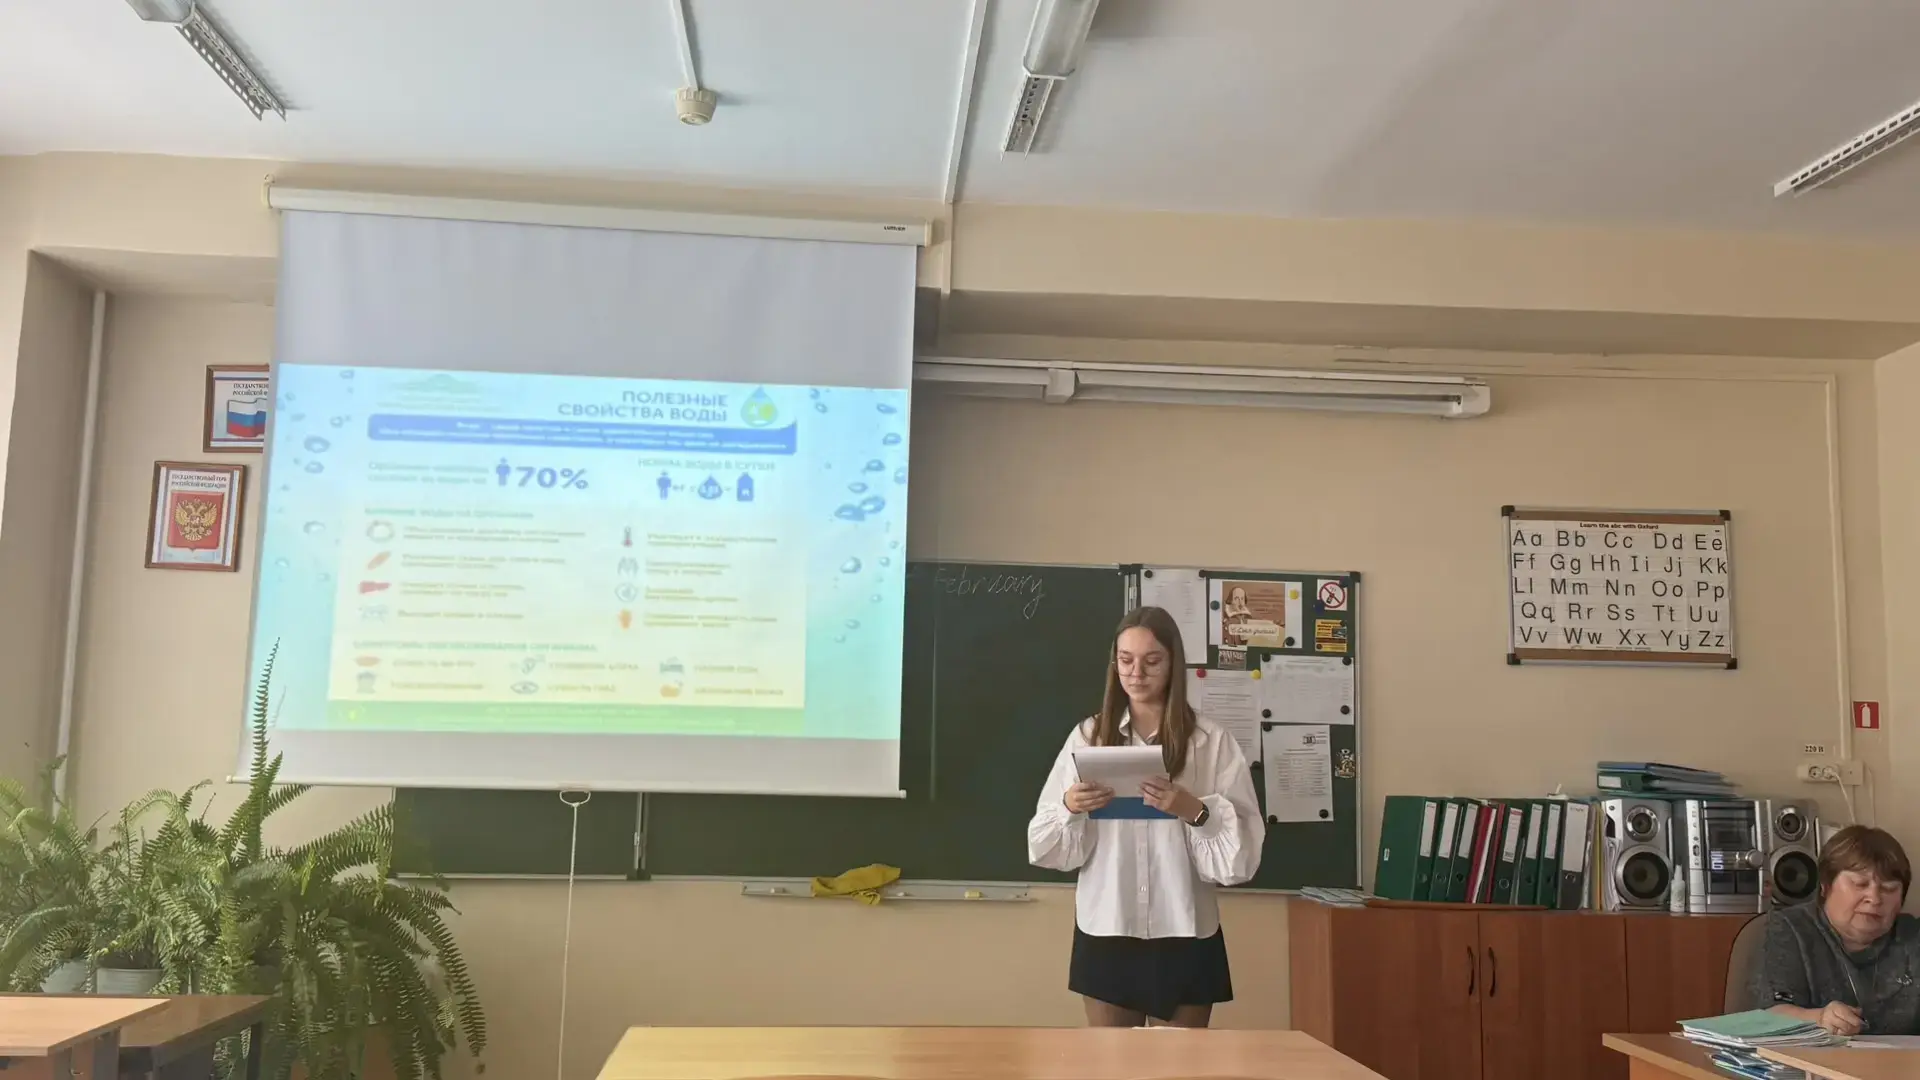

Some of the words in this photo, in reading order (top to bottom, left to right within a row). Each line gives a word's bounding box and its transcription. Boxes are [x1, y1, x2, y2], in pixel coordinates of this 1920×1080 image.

[622, 390, 728, 407] ПОЛЕЗНЫЕ
[558, 401, 664, 419] СВОЙСТВА
[670, 407, 727, 422] ВОДЫ
[516, 466, 589, 490] 70%
[1513, 530, 1542, 546] Aa
[1558, 530, 1585, 547] Bb
[1604, 532, 1633, 548] Cc
[1654, 533, 1683, 549] Dd
[1514, 553, 1535, 569] Ff
[1550, 554, 1581, 574] Gg
[1592, 555, 1620, 572] Hh
[1632, 556, 1649, 572] Ii
[1664, 557, 1682, 577] Jj
[1700, 558, 1727, 574] Kk
[934, 566, 1046, 619] February
[1514, 578, 1533, 593] Ll
[1551, 579, 1588, 595] Mm
[1606, 580, 1635, 596] Nn
[1652, 580, 1683, 597] Oo
[1697, 582, 1725, 601] Pp
[1521, 603, 1555, 623] Qq
[1569, 603, 1593, 619] Rr
[1607, 604, 1635, 620] Ss
[1653, 605, 1675, 621] Tt
[1690, 606, 1718, 623] Uu
[1520, 627, 1548, 643] Vv
[1564, 628, 1602, 645] Ww
[1619, 629, 1646, 645] Xx
[1661, 630, 1689, 650] Yy
[1699, 631, 1725, 647] Zz
[1805, 745, 1817, 753] 220
